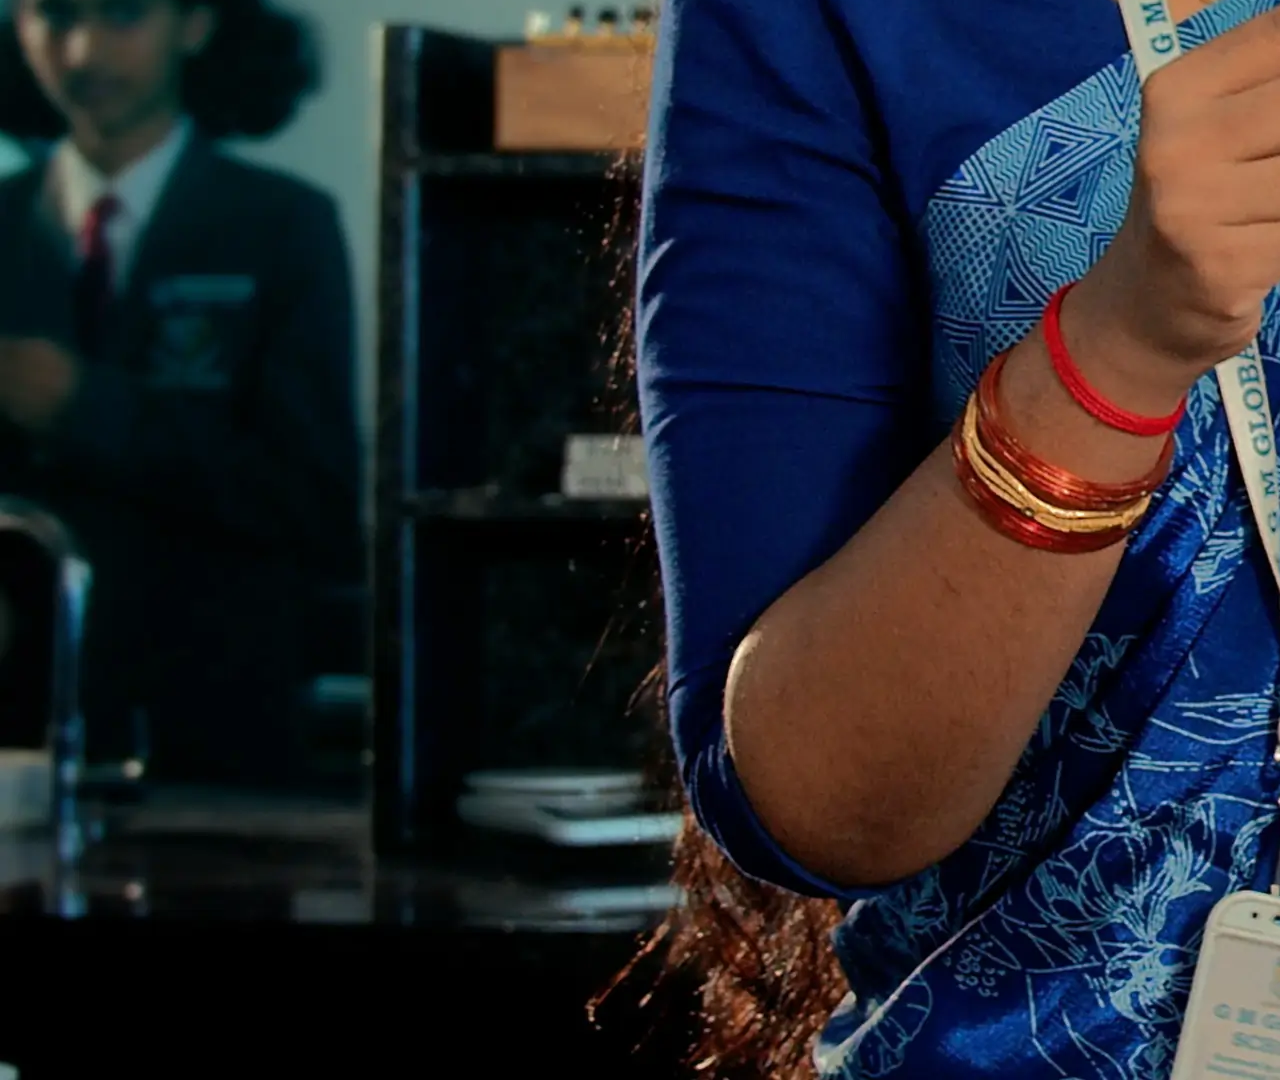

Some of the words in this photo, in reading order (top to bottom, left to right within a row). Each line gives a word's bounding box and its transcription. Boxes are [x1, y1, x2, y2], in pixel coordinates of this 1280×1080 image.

[1142, 4, 1168, 28] M
[1151, 33, 1174, 54] G
[1237, 344, 1271, 456] GLOBA
